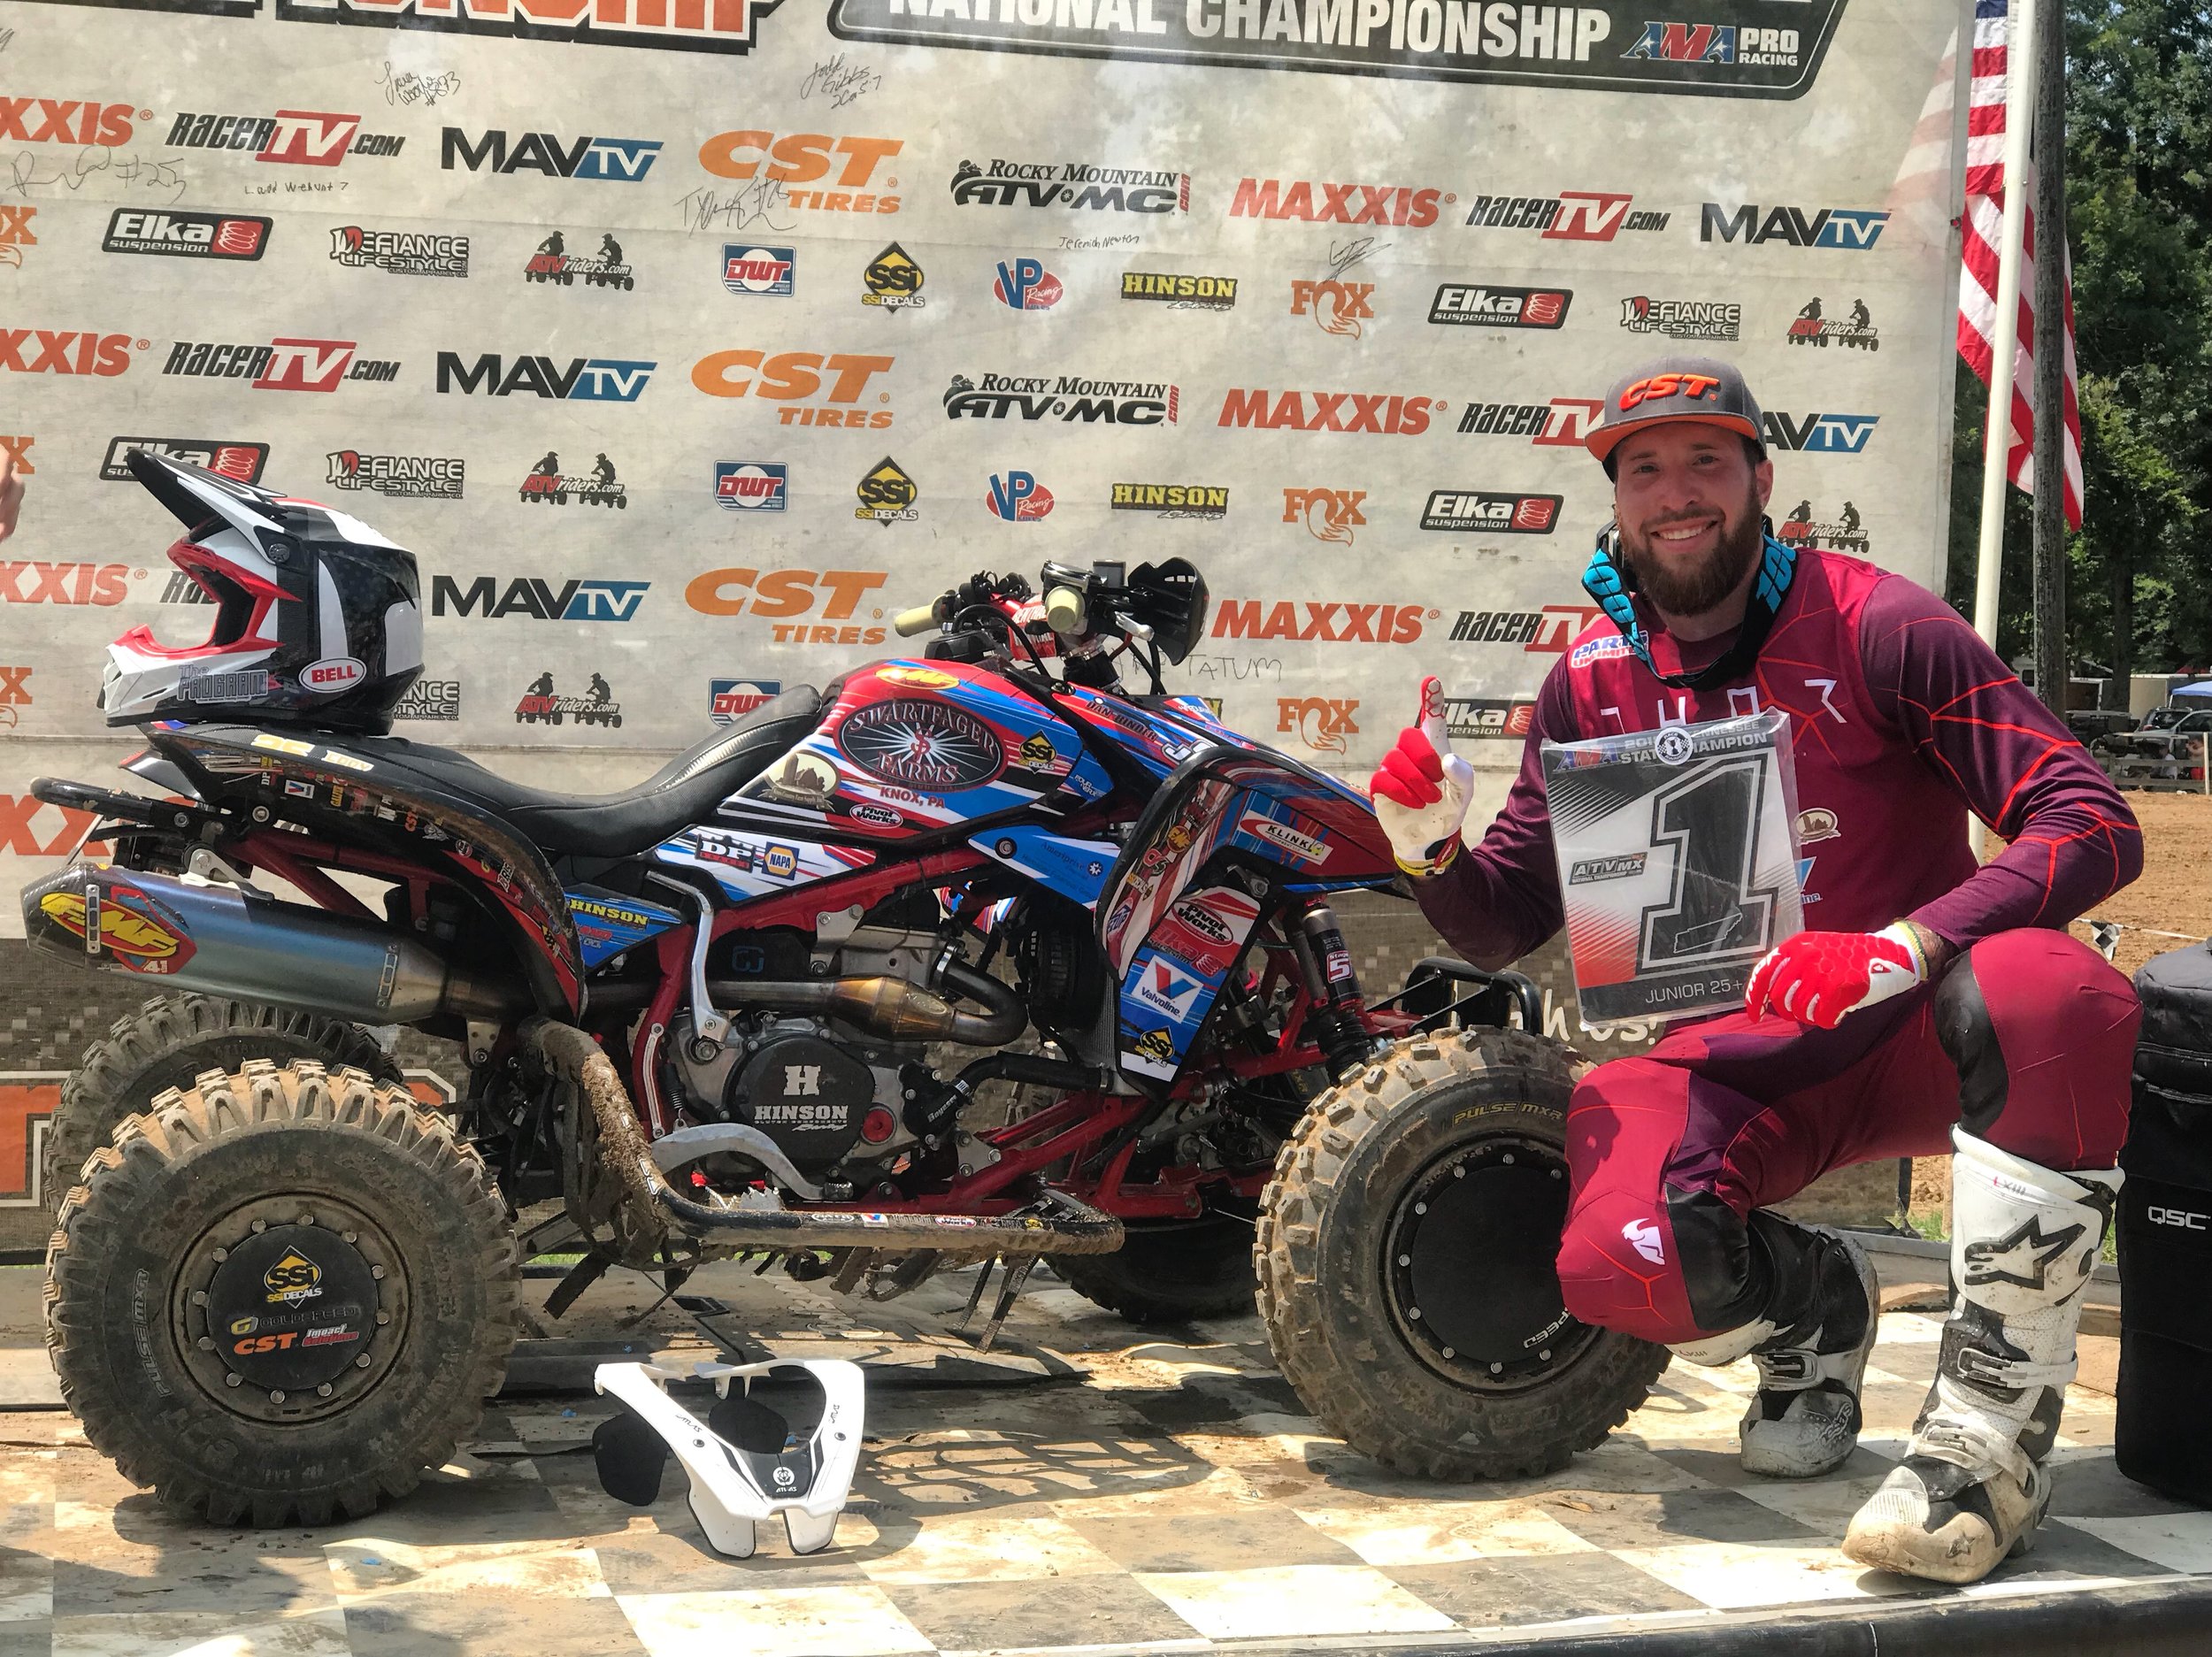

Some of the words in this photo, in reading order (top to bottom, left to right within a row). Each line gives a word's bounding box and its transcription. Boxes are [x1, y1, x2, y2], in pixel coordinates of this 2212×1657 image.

[1186, 0, 1611, 61] CHAMPIONSHIP
[1620, 22, 1735, 64] AMA
[1740, 27, 1799, 53] PRO
[1739, 51, 1798, 66] RACING
[442, 127, 664, 181] MAVTV
[698, 129, 904, 187] CST
[987, 159, 1058, 180] ROCKY
[1061, 163, 1178, 188] MOUNTAIN
[787, 190, 902, 213] TIRES
[1229, 178, 1442, 228] MAXXIS
[112, 212, 214, 242] Elka
[1700, 203, 1891, 249] MAVTV
[108, 239, 209, 253] suspension
[339, 254, 461, 272] LIFESTYLE
[725, 257, 792, 282] DWT
[996, 257, 1043, 310] VP
[1026, 286, 1062, 304] Racing
[1124, 274, 1235, 298] HINSON
[1291, 279, 1374, 320] FOX
[1439, 288, 1524, 313] Elka
[1433, 311, 1518, 324] suspension
[1629, 321, 1733, 336] LIFESTYLE
[437, 352, 657, 403] MAVTV
[691, 349, 895, 403] CST
[979, 372, 1051, 395] ROCKY
[1055, 376, 1167, 400] MOUNTAIN
[1618, 372, 1720, 412] CST
[778, 406, 893, 429] TIRES
[1217, 388, 1432, 436] MAXXIS
[1762, 411, 1880, 453] AVTV
[336, 477, 457, 494] LIFESTYLE
[718, 475, 784, 498] DWT
[989, 471, 1035, 522] VP
[1113, 484, 1227, 508] HINSON
[1018, 496, 1055, 514] Racing
[1283, 487, 1366, 526] FOX
[1429, 495, 1514, 519] Elka
[1425, 518, 1509, 529] suspension
[432, 575, 652, 621] MAVTV
[684, 568, 888, 620] CST
[771, 625, 887, 646] TIRES
[1210, 600, 1426, 645] MAXXIS
[1573, 646, 1639, 668] UNLIMITE
[179, 671, 267, 701] PROGRAM
[311, 664, 357, 693] BELL
[1277, 697, 1360, 734] FOX
[1443, 702, 1508, 726] lka
[849, 701, 997, 754] SWARTFAGER
[1447, 725, 1502, 735] pension
[1689, 720, 1760, 738] ENNESSEE
[878, 751, 959, 783] FARMS
[1621, 752, 1656, 764] STAT
[880, 786, 924, 807] KNOX,
[928, 795, 946, 809] PA
[856, 811, 898, 825] Works
[1268, 824, 1310, 849] KLINK
[701, 840, 752, 860] DP
[770, 854, 792, 869] NAPA
[1637, 748, 1779, 976] 1
[569, 898, 649, 925] HINSON
[1186, 902, 1230, 932] Pivot
[1178, 909, 1230, 942] Works
[1330, 958, 1352, 980] 5
[1141, 986, 1181, 1017] Valvoline
[1645, 984, 1705, 1004] JUNIOR
[1711, 979, 1743, 995] 25+
[784, 1065, 821, 1096] H
[754, 1105, 849, 1121] HINSON
[1453, 1101, 1517, 1127] PULSE
[2148, 1206, 2207, 1231] QSC
[307, 1323, 347, 1339] Impact
[1523, 1307, 1571, 1349] PEED
[234, 1332, 298, 1355] CST
[133, 1324, 173, 1396] PULSE
